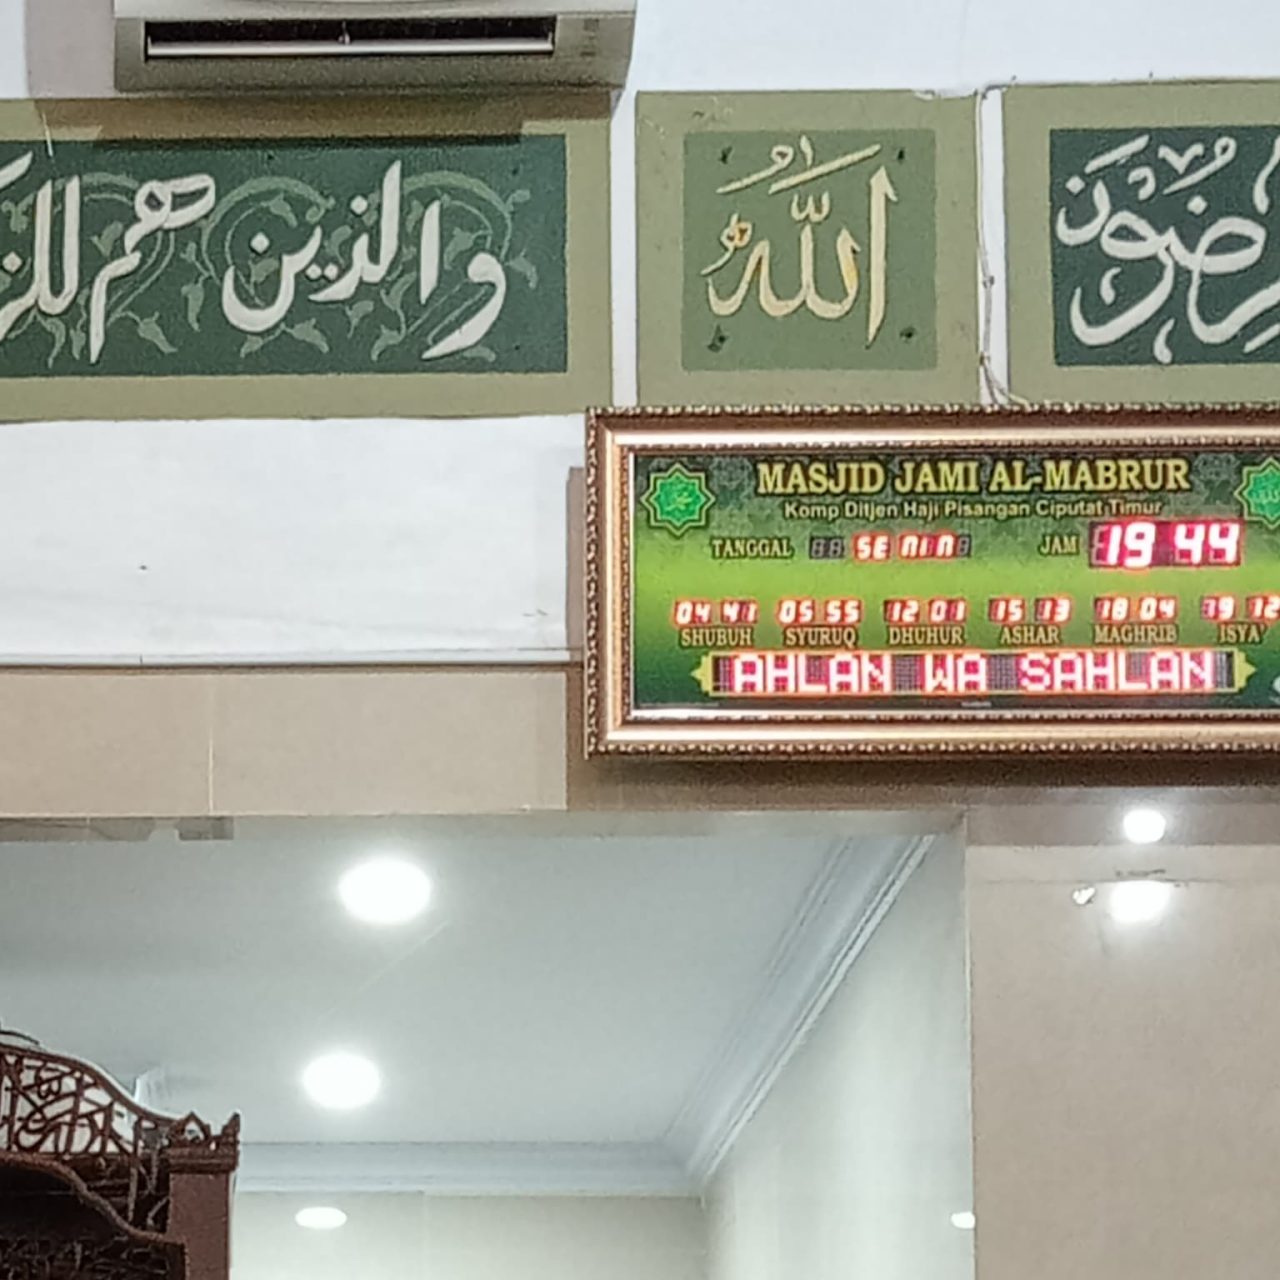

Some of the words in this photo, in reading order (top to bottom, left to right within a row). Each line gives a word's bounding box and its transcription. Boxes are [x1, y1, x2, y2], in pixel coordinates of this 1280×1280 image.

[756, 462, 886, 494] MASJID
[894, 461, 980, 493] JAMI
[988, 458, 1191, 492] AL-MABRUR
[784, 502, 839, 521] Komp
[844, 501, 898, 521] Ditjen
[903, 501, 939, 521] Haji
[944, 500, 1030, 520] Pisangan
[1035, 500, 1103, 519] Ciputat
[1108, 500, 1163, 515] Timur
[712, 538, 792, 557] TANGGAL
[1040, 535, 1079, 555] JAM
[681, 628, 753, 647] SHUBUH
[785, 627, 857, 648] SYURUQ
[889, 626, 964, 646] DHUHUR
[1000, 624, 1060, 645] ASHAR
[1094, 624, 1177, 644] MAGHRIB
[734, 652, 893, 692] AHLAN
[924, 652, 986, 691] WA
[1021, 650, 1214, 690] SAHLAN
